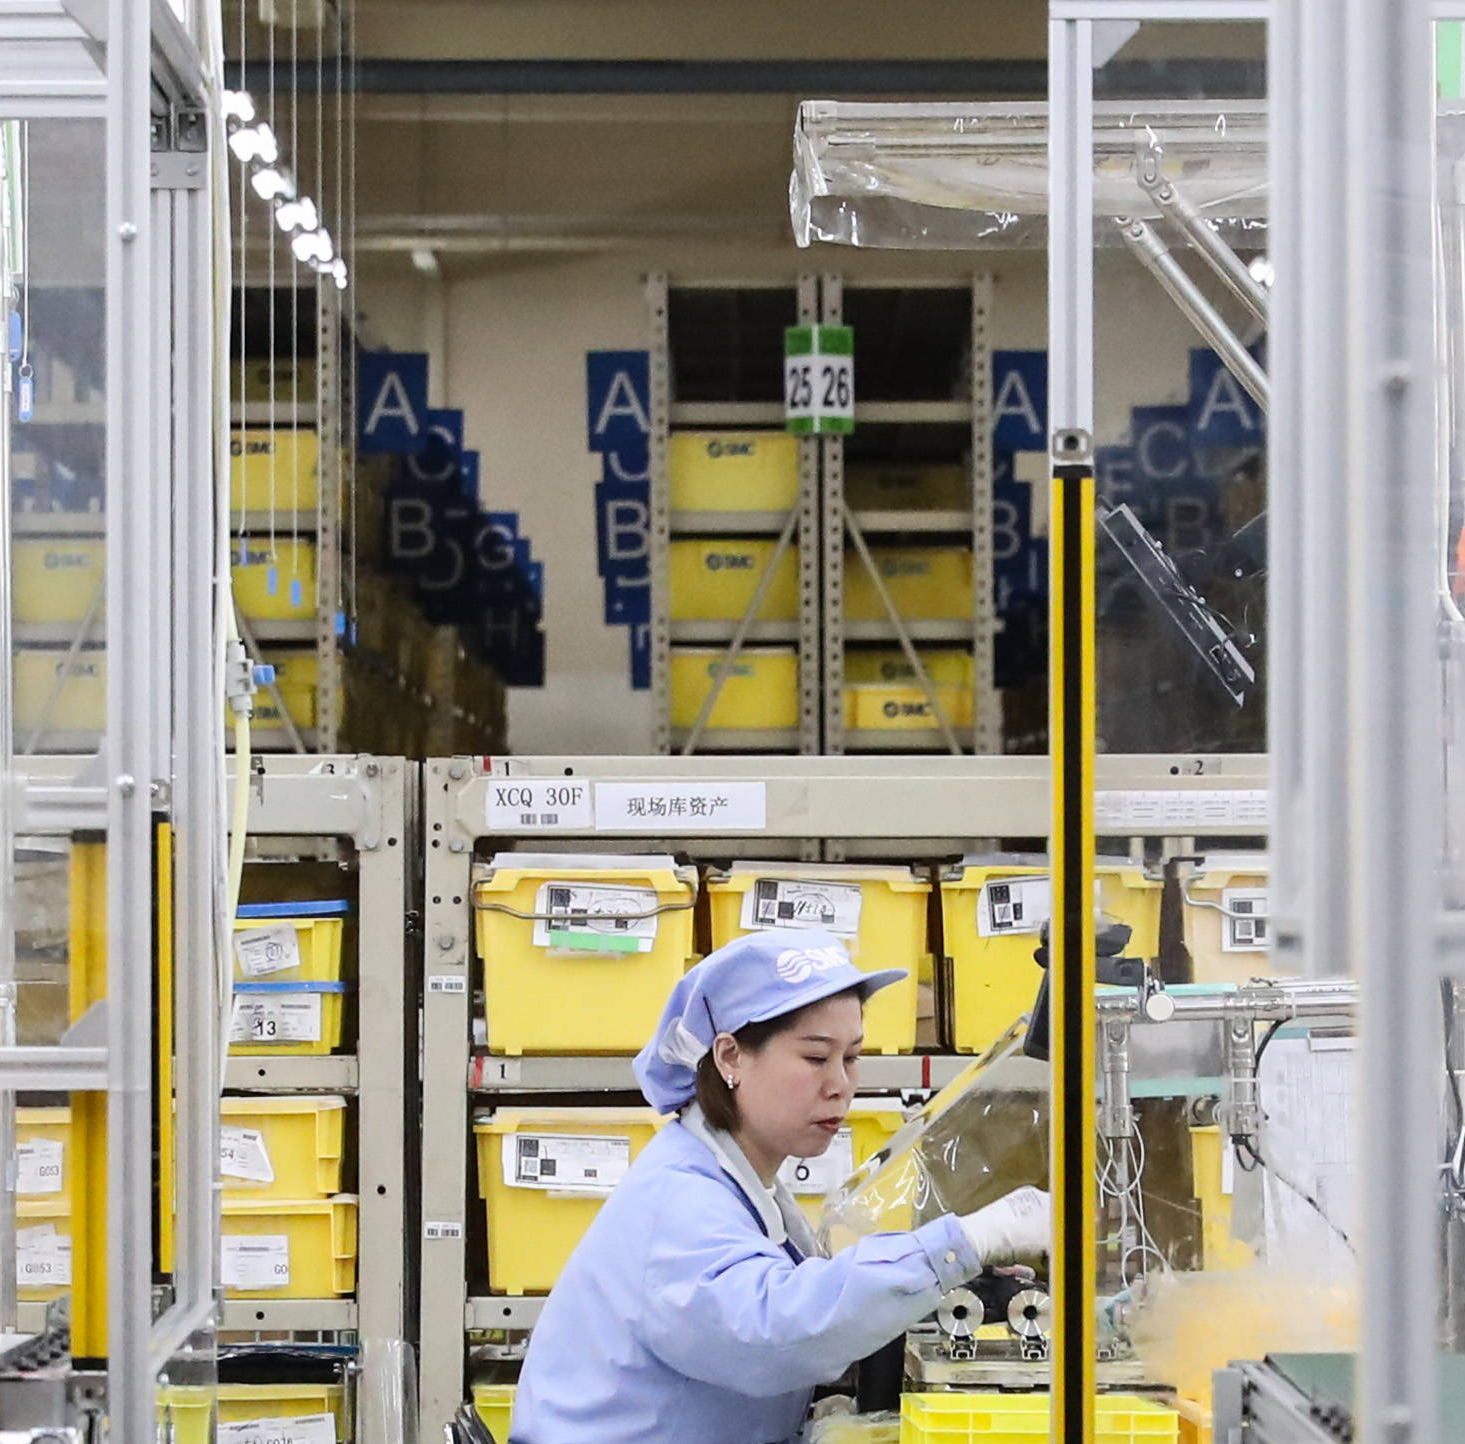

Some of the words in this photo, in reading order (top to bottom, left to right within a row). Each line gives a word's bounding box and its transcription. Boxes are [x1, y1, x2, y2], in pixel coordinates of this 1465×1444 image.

[364, 372, 419, 435] A
[595, 371, 649, 435] A
[789, 366, 813, 408] 25
[822, 367, 850, 408] 26
[993, 369, 1042, 434] A
[1197, 367, 1255, 431] A
[1140, 421, 1189, 479] C
[390, 498, 435, 559] B
[607, 499, 650, 560] B
[1194, 760, 1204, 775] 2
[496, 787, 533, 808] XCQ
[545, 787, 583, 807] 30F
[626, 796, 729, 817] 现场库资产
[499, 1063, 507, 1079] 1
